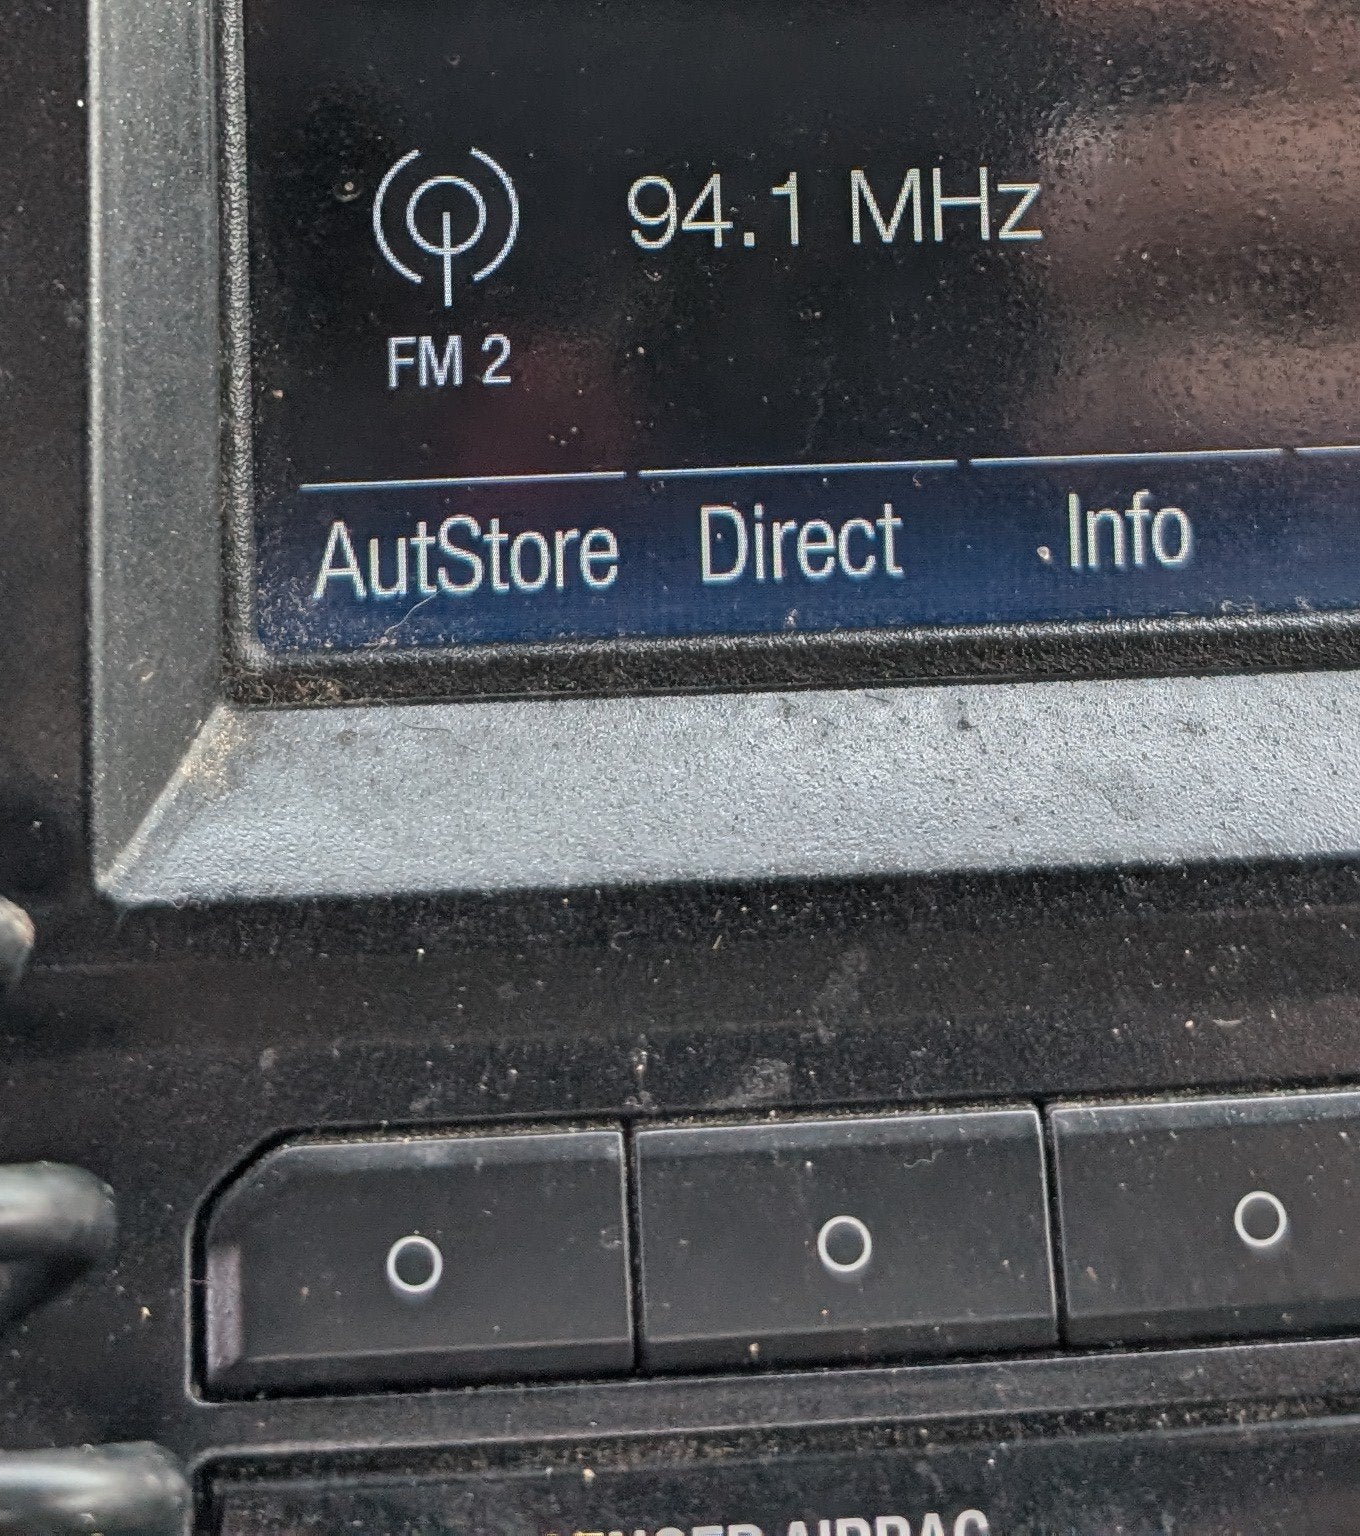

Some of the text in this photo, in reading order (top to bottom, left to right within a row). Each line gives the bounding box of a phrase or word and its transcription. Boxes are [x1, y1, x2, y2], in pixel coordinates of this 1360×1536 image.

[626, 168, 1043, 250] 94.1 MHz
[386, 334, 512, 388] FM 2
[312, 490, 1192, 600] AutStore Direct Info
